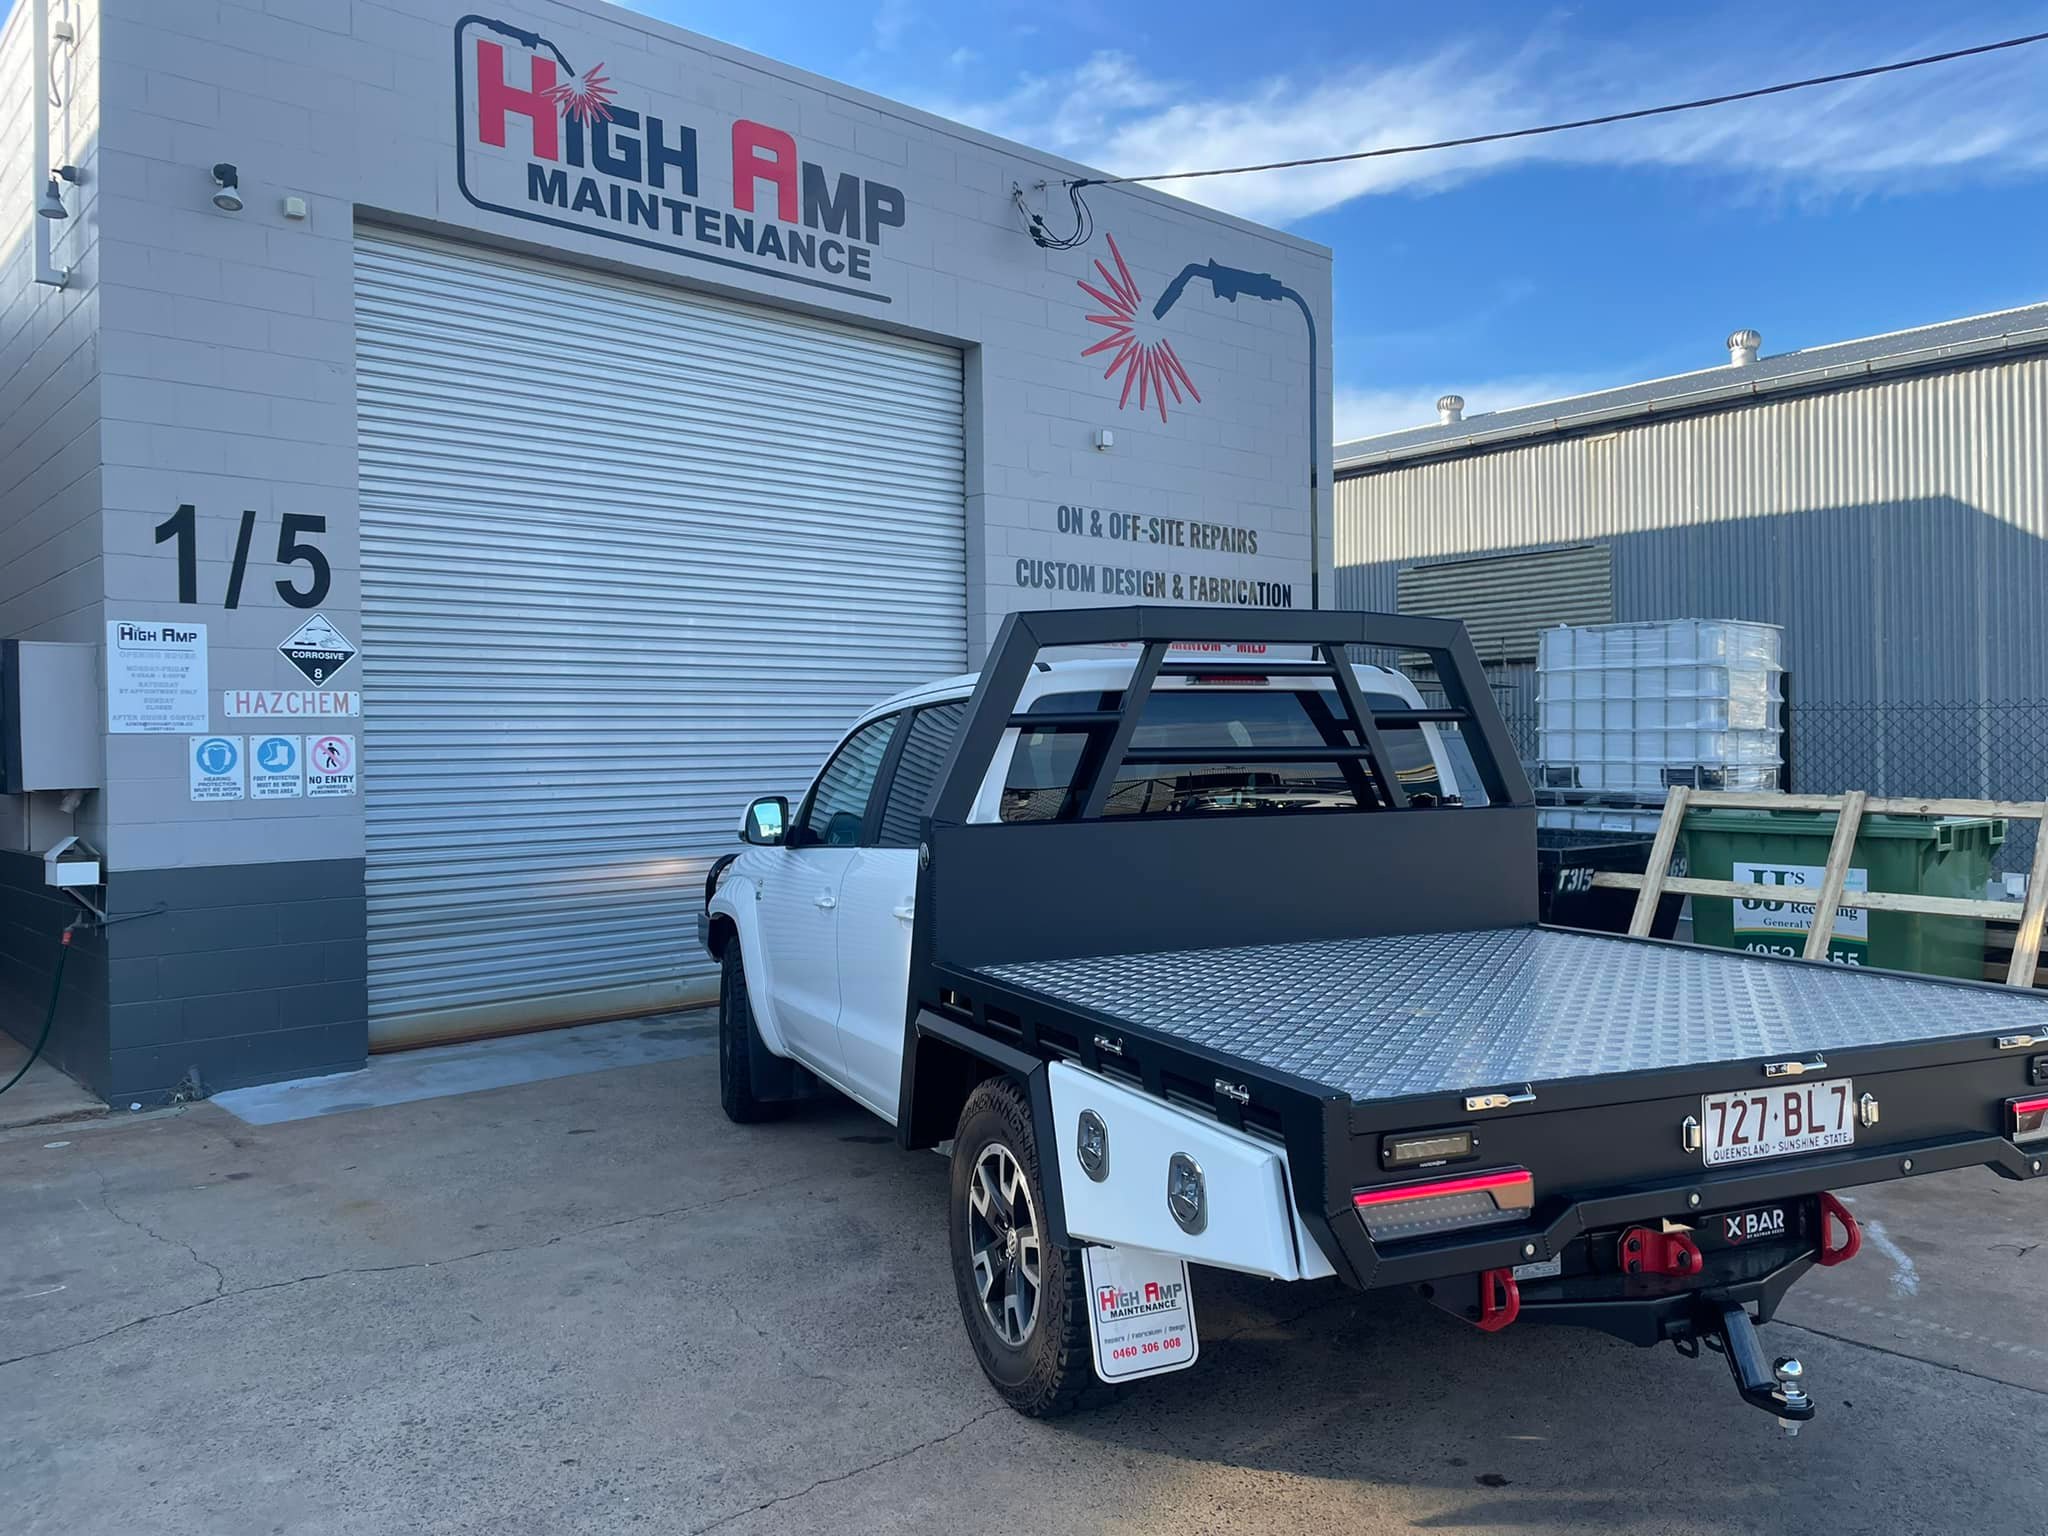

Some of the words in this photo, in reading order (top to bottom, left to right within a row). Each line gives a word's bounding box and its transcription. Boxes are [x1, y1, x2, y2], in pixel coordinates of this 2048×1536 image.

[477, 39, 698, 197] HIGH
[732, 119, 906, 246] AMP
[527, 163, 872, 281] MAINTENANCE
[1057, 505, 1083, 535] ON
[1090, 509, 1103, 538] &
[1109, 512, 1184, 547] OFF-SITE
[1190, 522, 1258, 555] REPAIRS
[155, 504, 331, 610] 1/5
[1016, 558, 1095, 593] CUSTOM
[1102, 567, 1166, 599] DESIGN
[1172, 573, 1184, 600] &
[1189, 575, 1292, 608] FABRICATION
[120, 627, 157, 641] HIGH
[162, 628, 197, 642] AMP
[292, 650, 344, 661] CORROSIVE
[314, 668, 322, 679] 8
[236, 692, 349, 714] HAZCHEM
[309, 776, 322, 784] NO
[325, 775, 354, 784] ENTRY
[1763, 918, 1803, 928] General
[1791, 903, 1858, 921] Recing
[1714, 1144, 1770, 1160] QUEENSLAND
[1778, 1137, 1820, 1151] SUNSHINE
[1823, 1133, 1848, 1145] STATE
[1727, 1216, 1743, 1237] X
[1746, 1209, 1785, 1233] BAR
[1100, 1289, 1139, 1311] HIGH
[1144, 1282, 1182, 1303] AMP
[1110, 1299, 1177, 1319] MAINTENANCE
[1113, 1346, 1137, 1360] 0460
[1141, 1341, 1159, 1354] 306
[1163, 1337, 1181, 1350] 008
